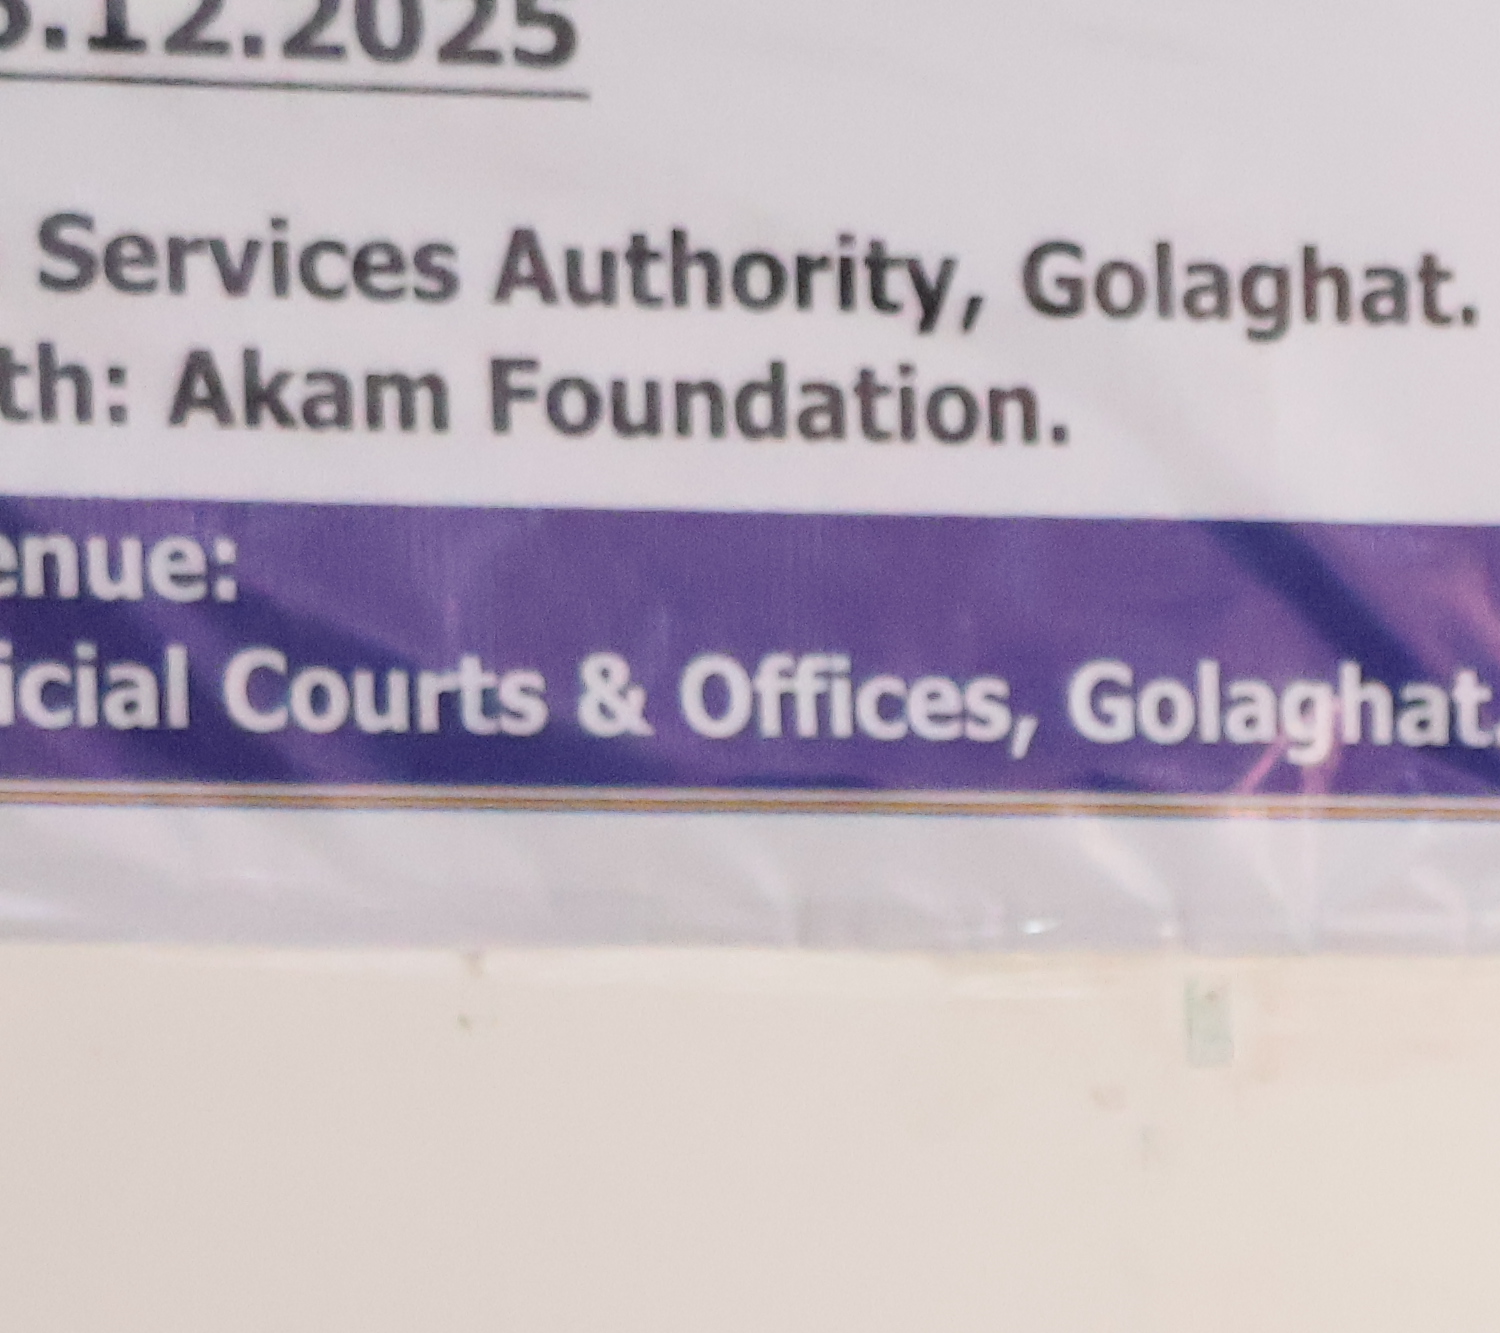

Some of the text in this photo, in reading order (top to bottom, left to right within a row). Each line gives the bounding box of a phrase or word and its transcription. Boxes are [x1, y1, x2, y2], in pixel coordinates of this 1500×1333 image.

[0, 0, 576, 69] .12.2025
[37, 212, 1476, 342] Services Authority, Golaghat.
[169, 348, 448, 432] Akam
[490, 357, 1067, 444] Foundation.
[223, 648, 548, 734] Courts
[578, 653, 652, 736] &
[680, 653, 1036, 758] Offices,
